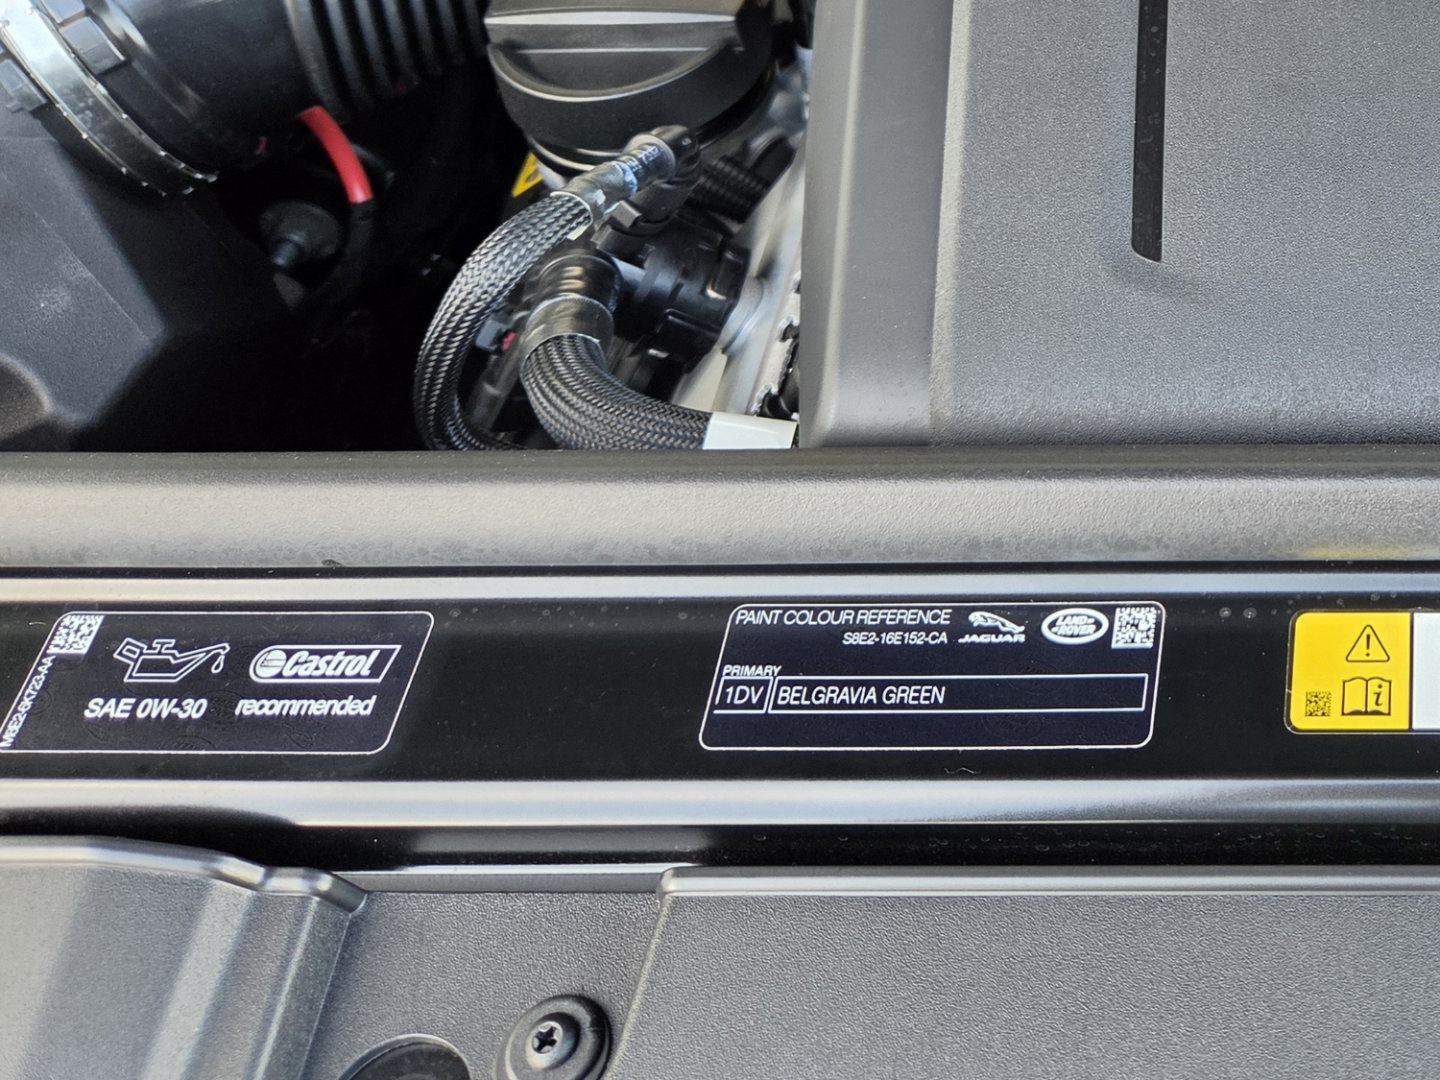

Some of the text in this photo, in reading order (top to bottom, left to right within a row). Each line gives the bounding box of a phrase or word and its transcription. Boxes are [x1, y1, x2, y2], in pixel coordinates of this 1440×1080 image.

[735, 609, 952, 625] PAINT COLOUR REFERENCE
[842, 632, 948, 644] S8E2-16E152-CA
[958, 634, 1026, 643] JAGUAR
[282, 649, 381, 677] Castrol
[722, 665, 782, 677] PRIMARY
[725, 686, 764, 704] 1DV
[776, 686, 946, 705] BELGRAVIA GREEN
[84, 697, 208, 719] SAE 0W-30
[235, 695, 377, 716] recommended
